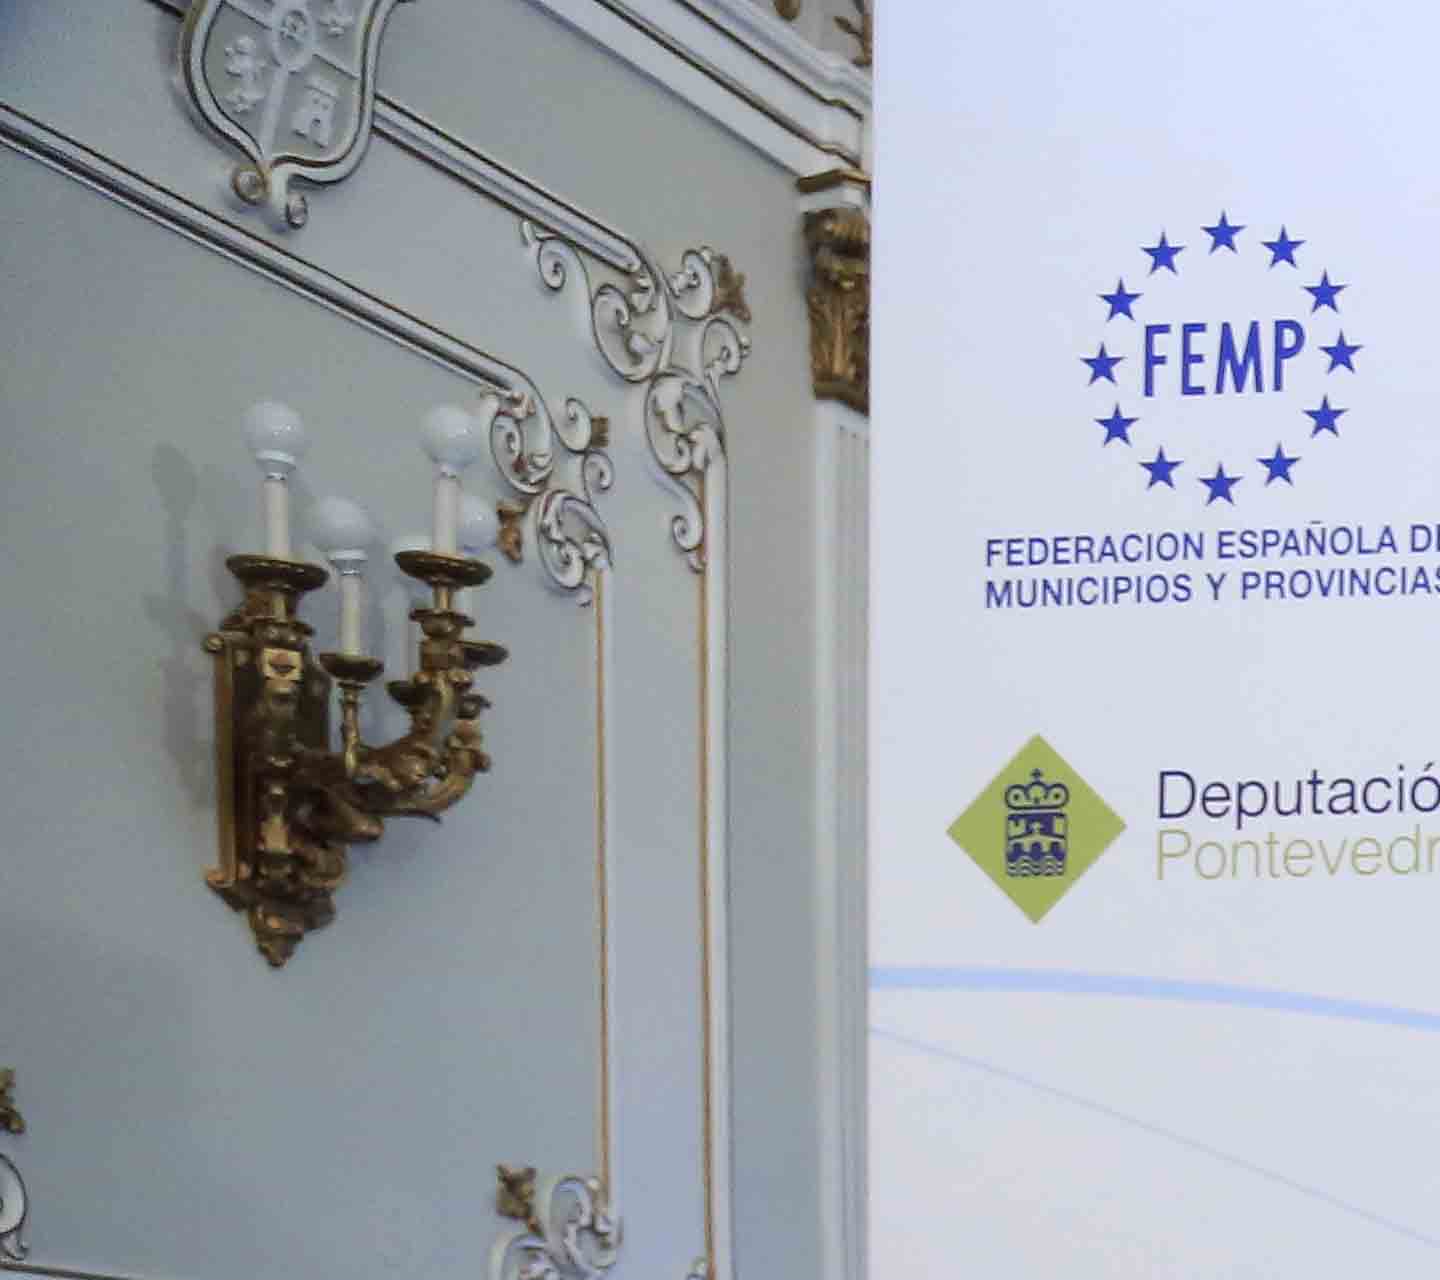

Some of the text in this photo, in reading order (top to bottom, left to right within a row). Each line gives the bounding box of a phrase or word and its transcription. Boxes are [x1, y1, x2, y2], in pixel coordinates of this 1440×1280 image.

[1142, 319, 1306, 398] FEMP
[985, 531, 1206, 568] FEDERACION
[1216, 520, 1399, 560] ESPAÑOLA
[984, 573, 1193, 609] MUNICIPIOS
[1206, 573, 1228, 601] Y
